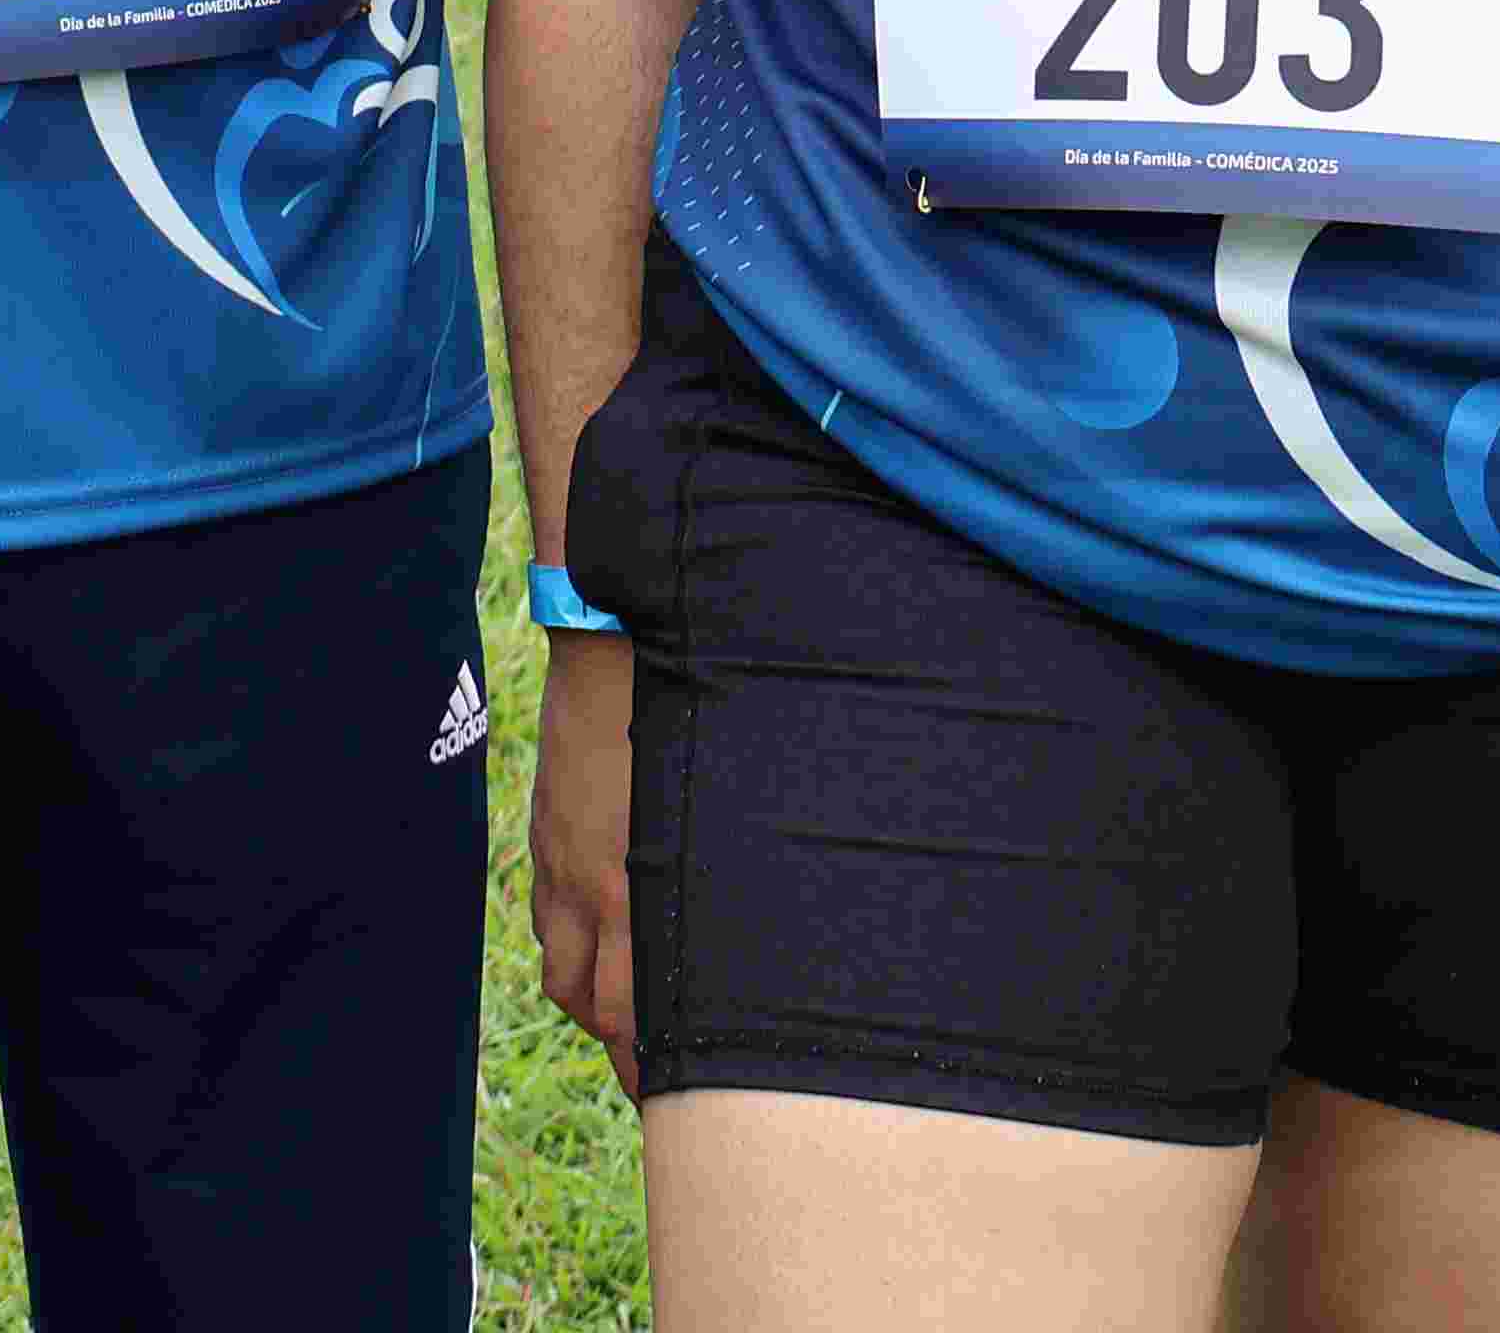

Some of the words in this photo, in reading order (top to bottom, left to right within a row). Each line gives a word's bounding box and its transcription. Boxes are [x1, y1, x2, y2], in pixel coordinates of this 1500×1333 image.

[59, 16, 84, 33] Día
[86, 14, 105, 29] de
[107, 13, 122, 27] la
[124, 5, 176, 26] Familia
[1064, 148, 1090, 166] Día
[1092, 150, 1112, 166] de
[1114, 151, 1130, 166] la
[1133, 151, 1193, 169] Familia
[1206, 151, 1294, 173] COMÉDICA
[1297, 156, 1340, 175] 2025
[428, 707, 489, 765] adidas
